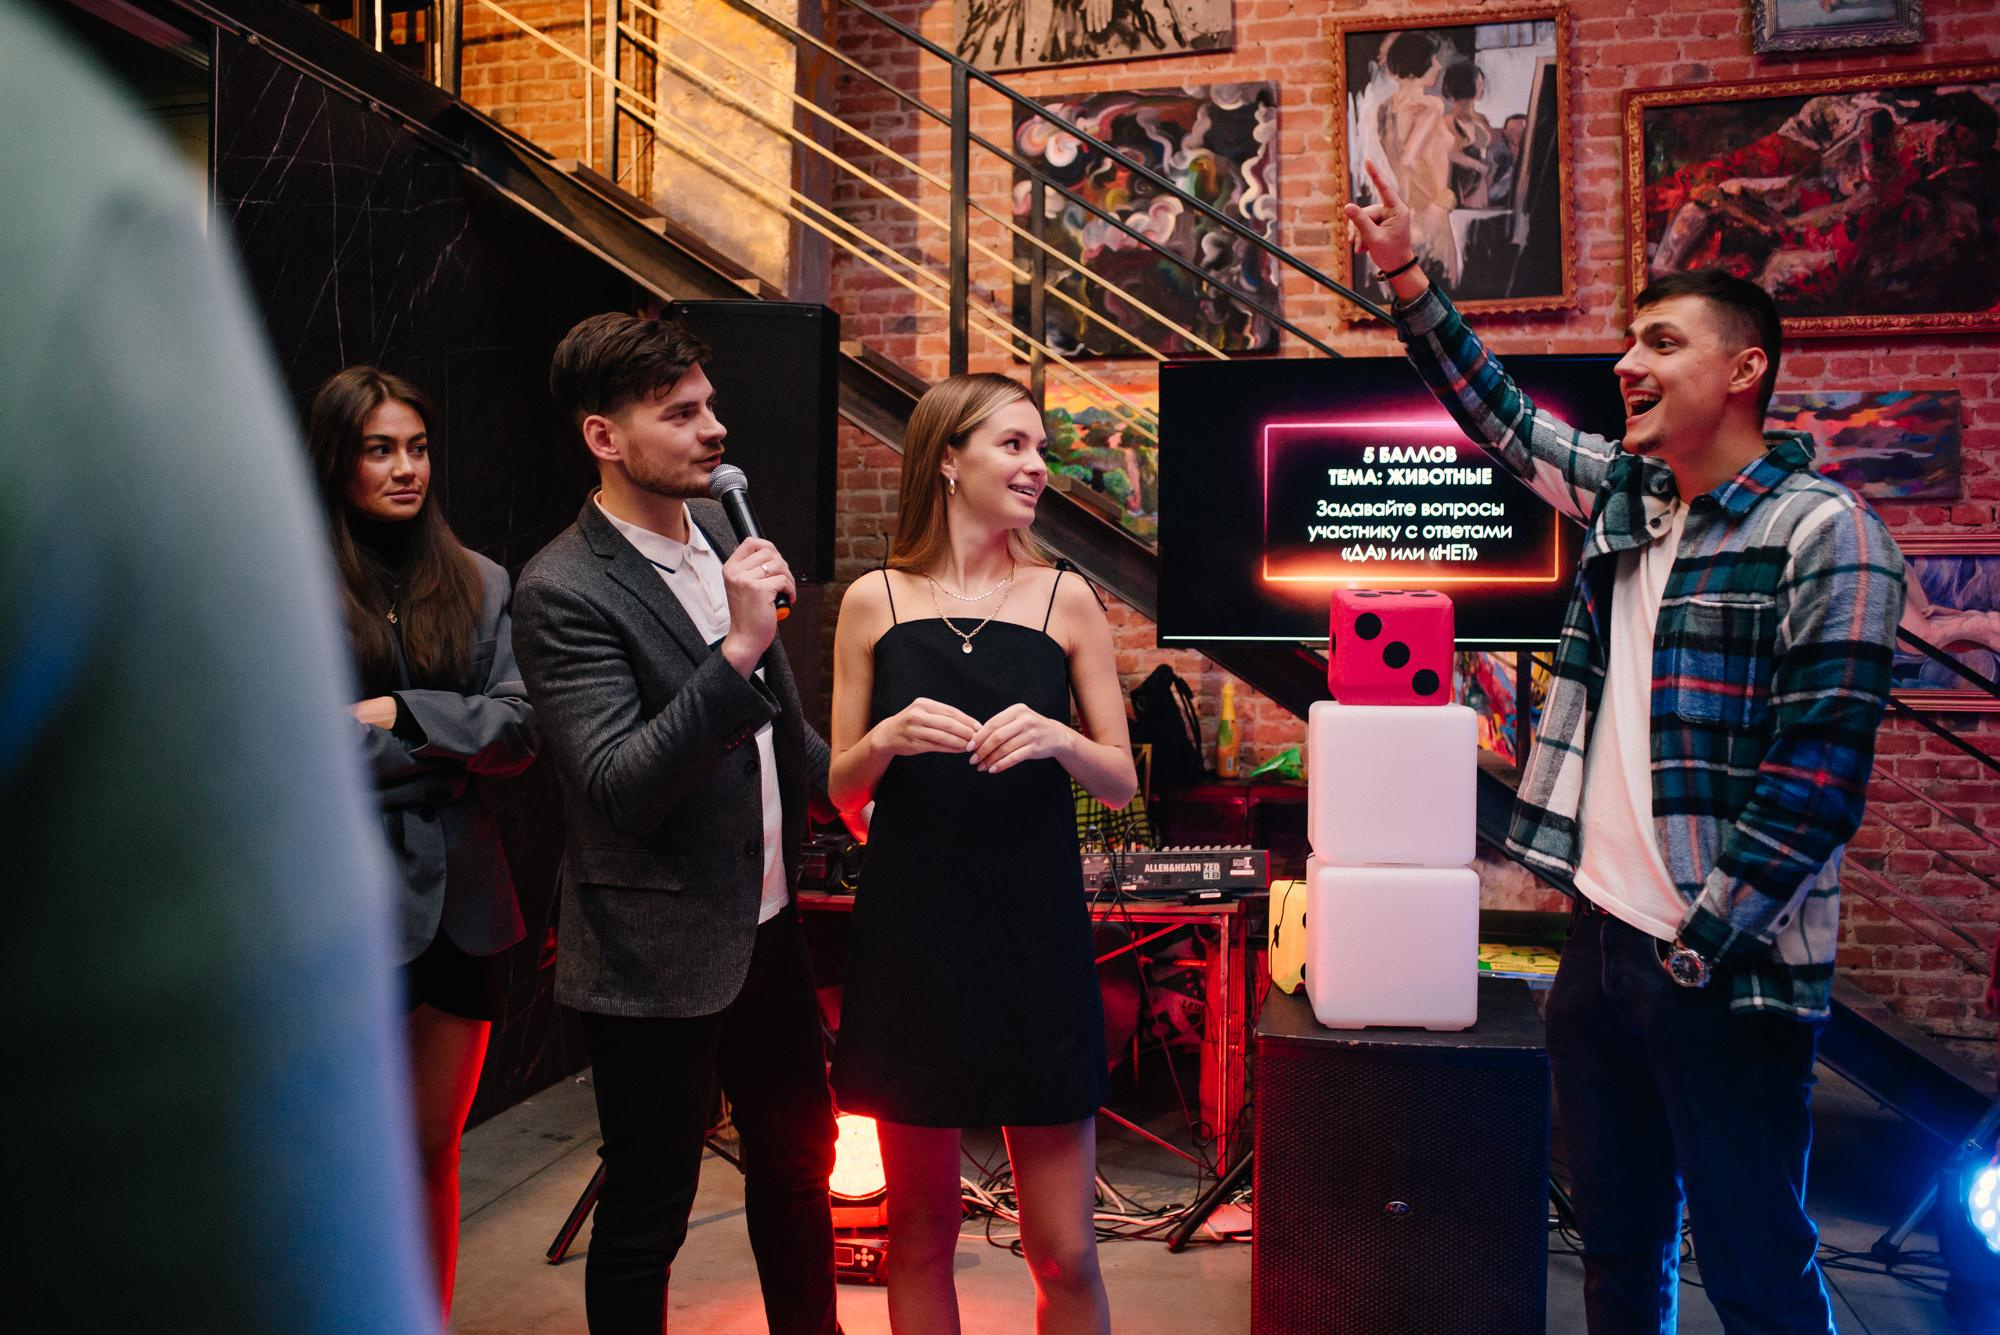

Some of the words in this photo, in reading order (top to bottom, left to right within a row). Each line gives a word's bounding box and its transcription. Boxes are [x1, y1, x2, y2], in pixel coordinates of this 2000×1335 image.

[1363, 447, 1374, 463] 5
[1379, 446, 1457, 463] БАЛЛОВ
[1328, 469, 1382, 485] ТЕМА:
[1387, 468, 1492, 485] ЖИВОТНЫЕ
[1316, 500, 1416, 517] Задавайте
[1422, 503, 1504, 519] вопросы
[1308, 525, 1401, 542] участнику
[1405, 525, 1418, 538] с
[1423, 525, 1512, 538] ответами
[1341, 544, 1387, 562] «ДА»
[1391, 548, 1424, 560] или
[1428, 544, 1478, 560] «НЕТ»
[1144, 862, 1201, 873] ALLEN&HEATH
[1203, 863, 1220, 871] ZED
